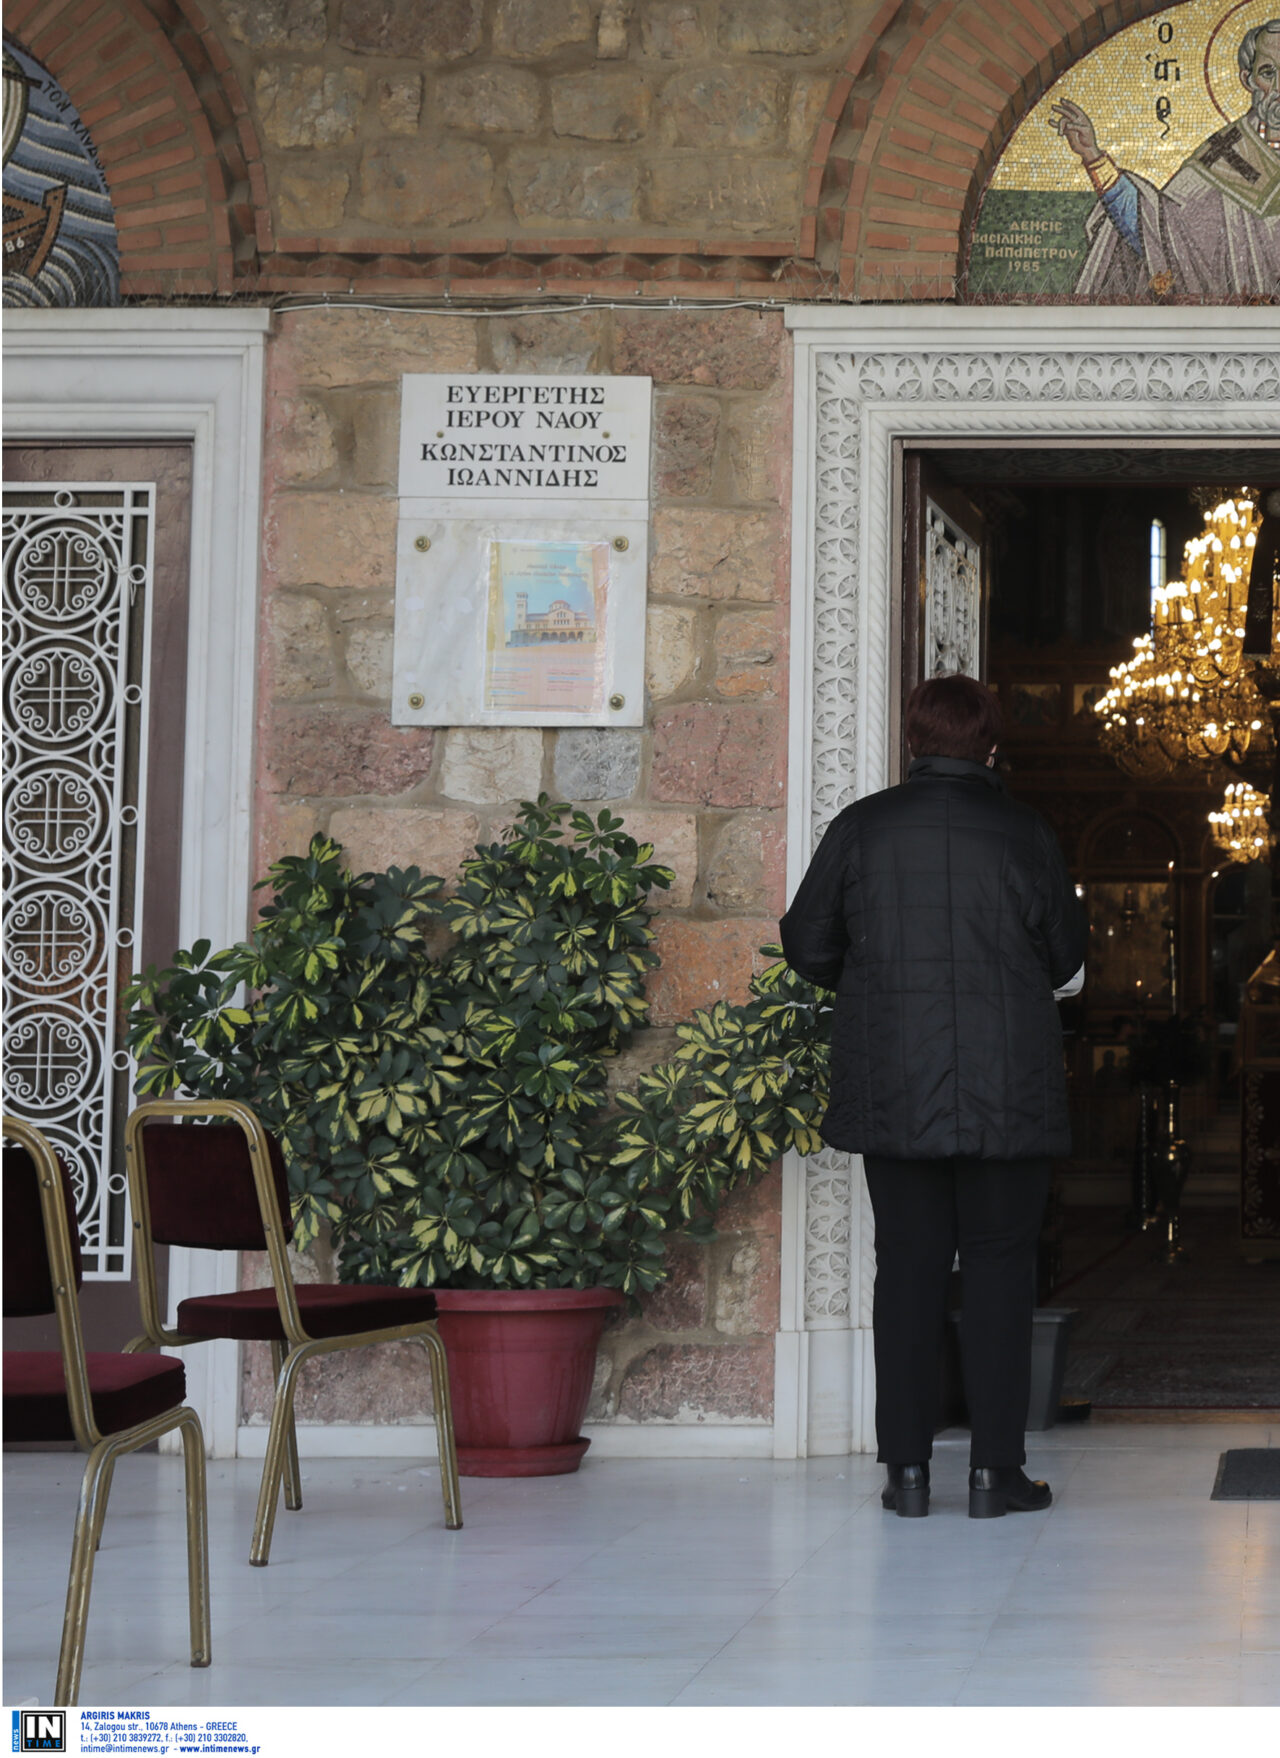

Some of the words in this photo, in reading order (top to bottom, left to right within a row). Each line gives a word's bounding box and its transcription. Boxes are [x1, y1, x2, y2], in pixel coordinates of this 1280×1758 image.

[1008, 260, 1041, 273] 1985
[448, 386, 604, 404] ΕΥΕΡΓΕΤΗΣ
[448, 411, 523, 427] ΙΕΡΟΥ
[538, 412, 600, 428] ΝΑΟΥ
[423, 444, 625, 462] ΚΩΝΣΤΑΝΤΙΝΟΣ
[449, 469, 597, 486] ΙΩΑΝΝΙΔΗΣ
